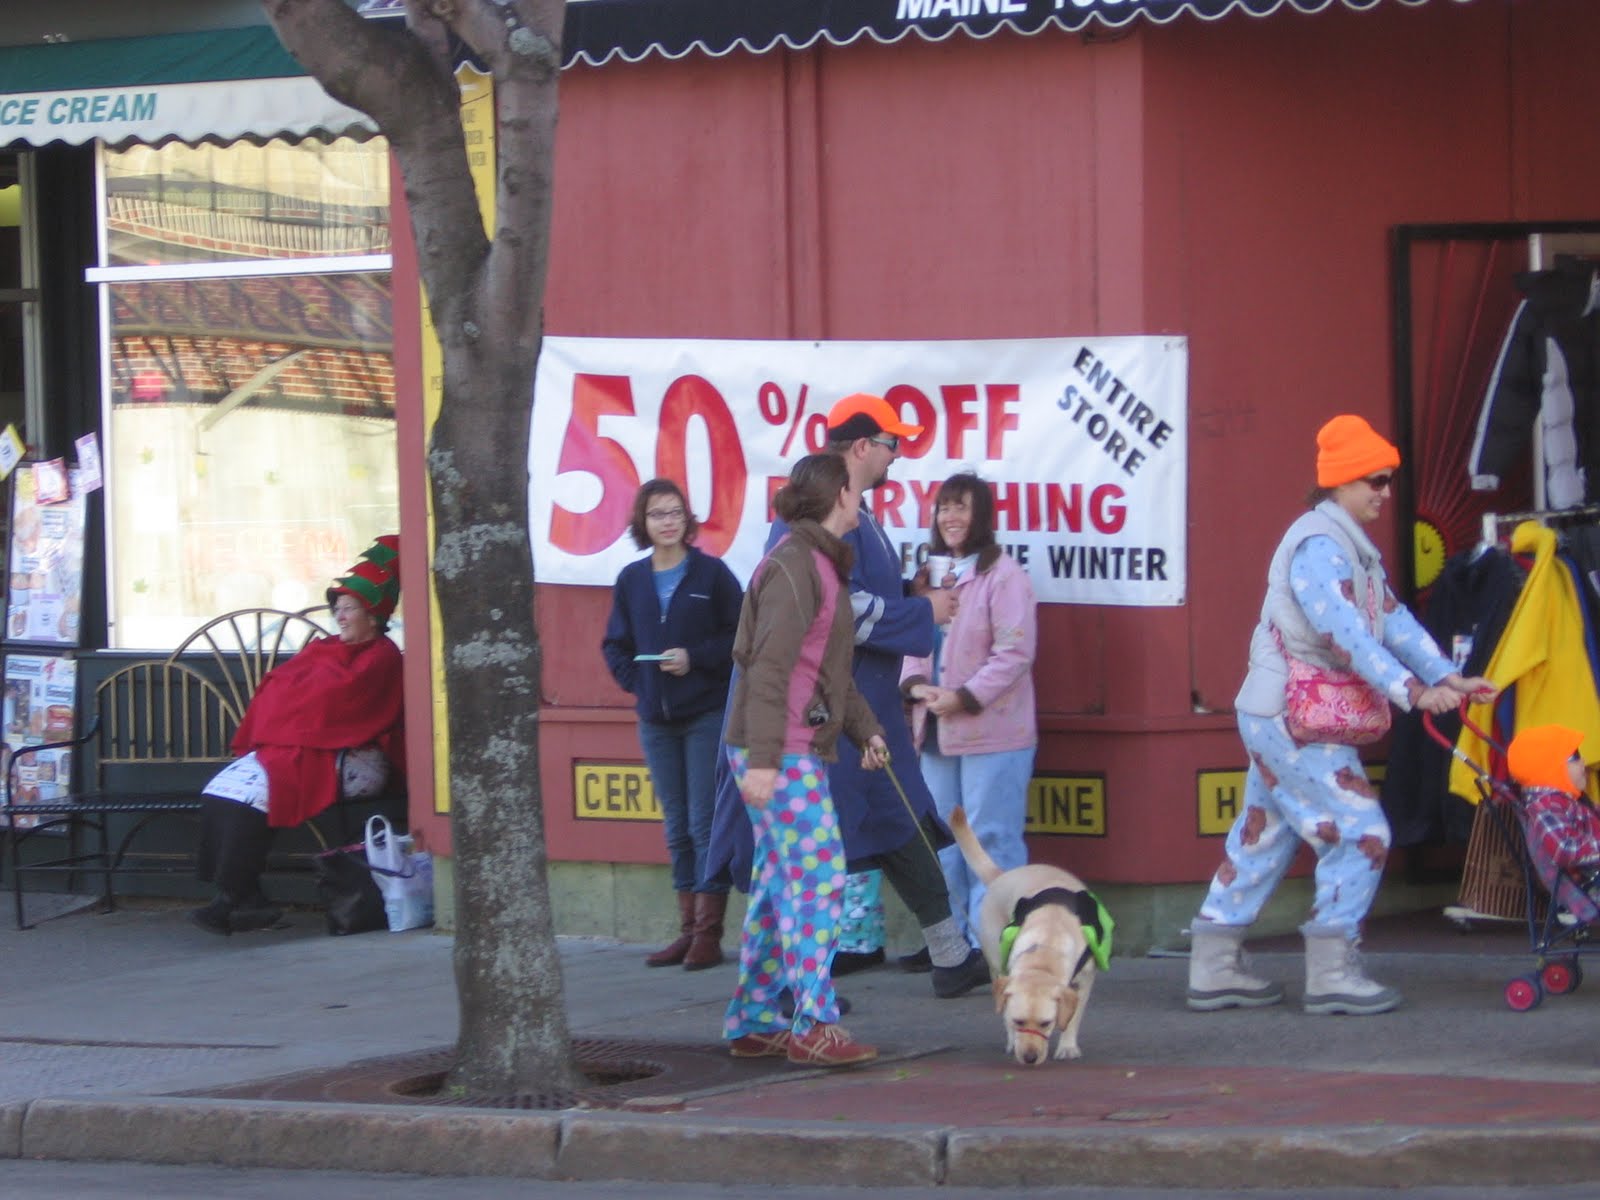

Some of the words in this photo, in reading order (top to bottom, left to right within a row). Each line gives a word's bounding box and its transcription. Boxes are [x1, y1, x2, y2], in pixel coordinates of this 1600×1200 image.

[47, 93, 157, 125] CREAM
[882, 383, 1020, 460] OFF
[1072, 346, 1174, 450] ENTIRE
[1056, 384, 1146, 478] STORE
[1048, 545, 1168, 581] WINTER
[1025, 784, 1094, 827] INE
